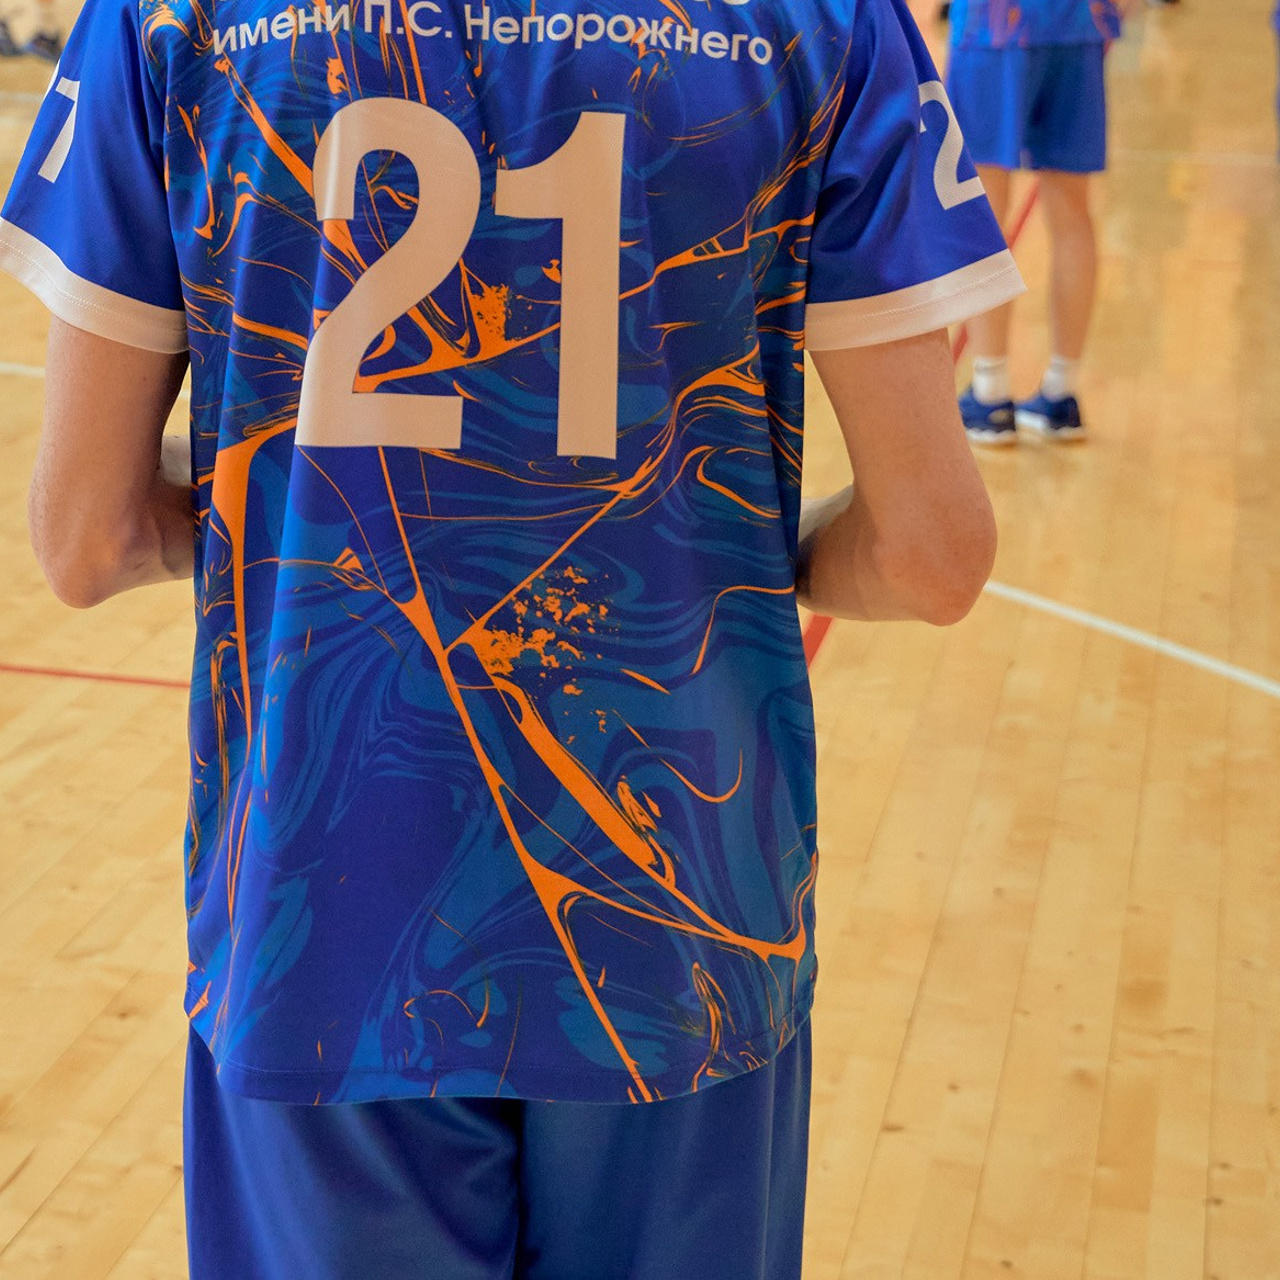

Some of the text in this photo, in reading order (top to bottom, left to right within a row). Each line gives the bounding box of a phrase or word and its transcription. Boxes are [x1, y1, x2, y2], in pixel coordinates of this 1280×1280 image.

[212, 1, 352, 55] имени
[465, 4, 775, 66] Непорожнего
[294, 96, 627, 460] 21
